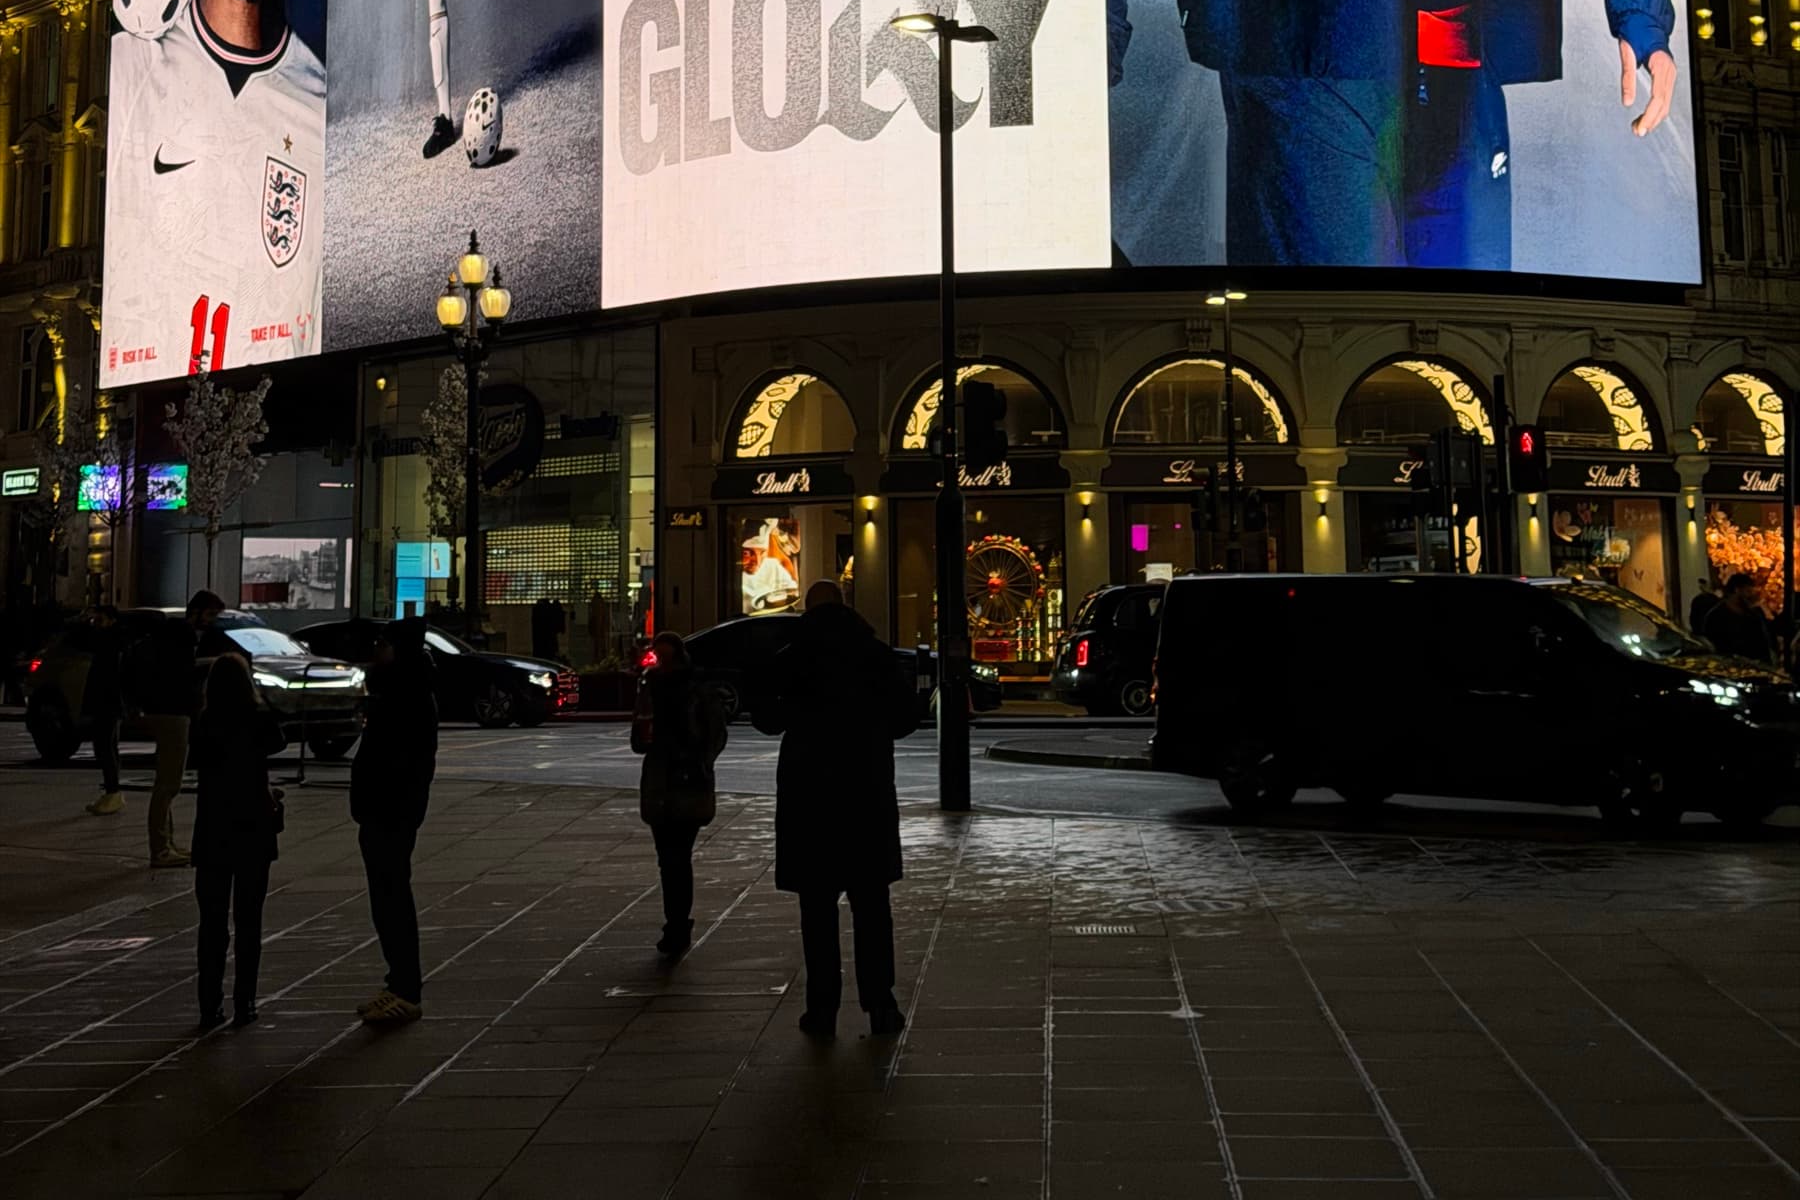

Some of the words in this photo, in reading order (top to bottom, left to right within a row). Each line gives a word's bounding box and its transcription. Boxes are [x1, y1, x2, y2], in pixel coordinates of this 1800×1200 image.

[188, 294, 230, 375] 11
[752, 471, 800, 494] Lindt
[1584, 465, 1629, 487] Lindt
[1739, 470, 1780, 492] Lindt
